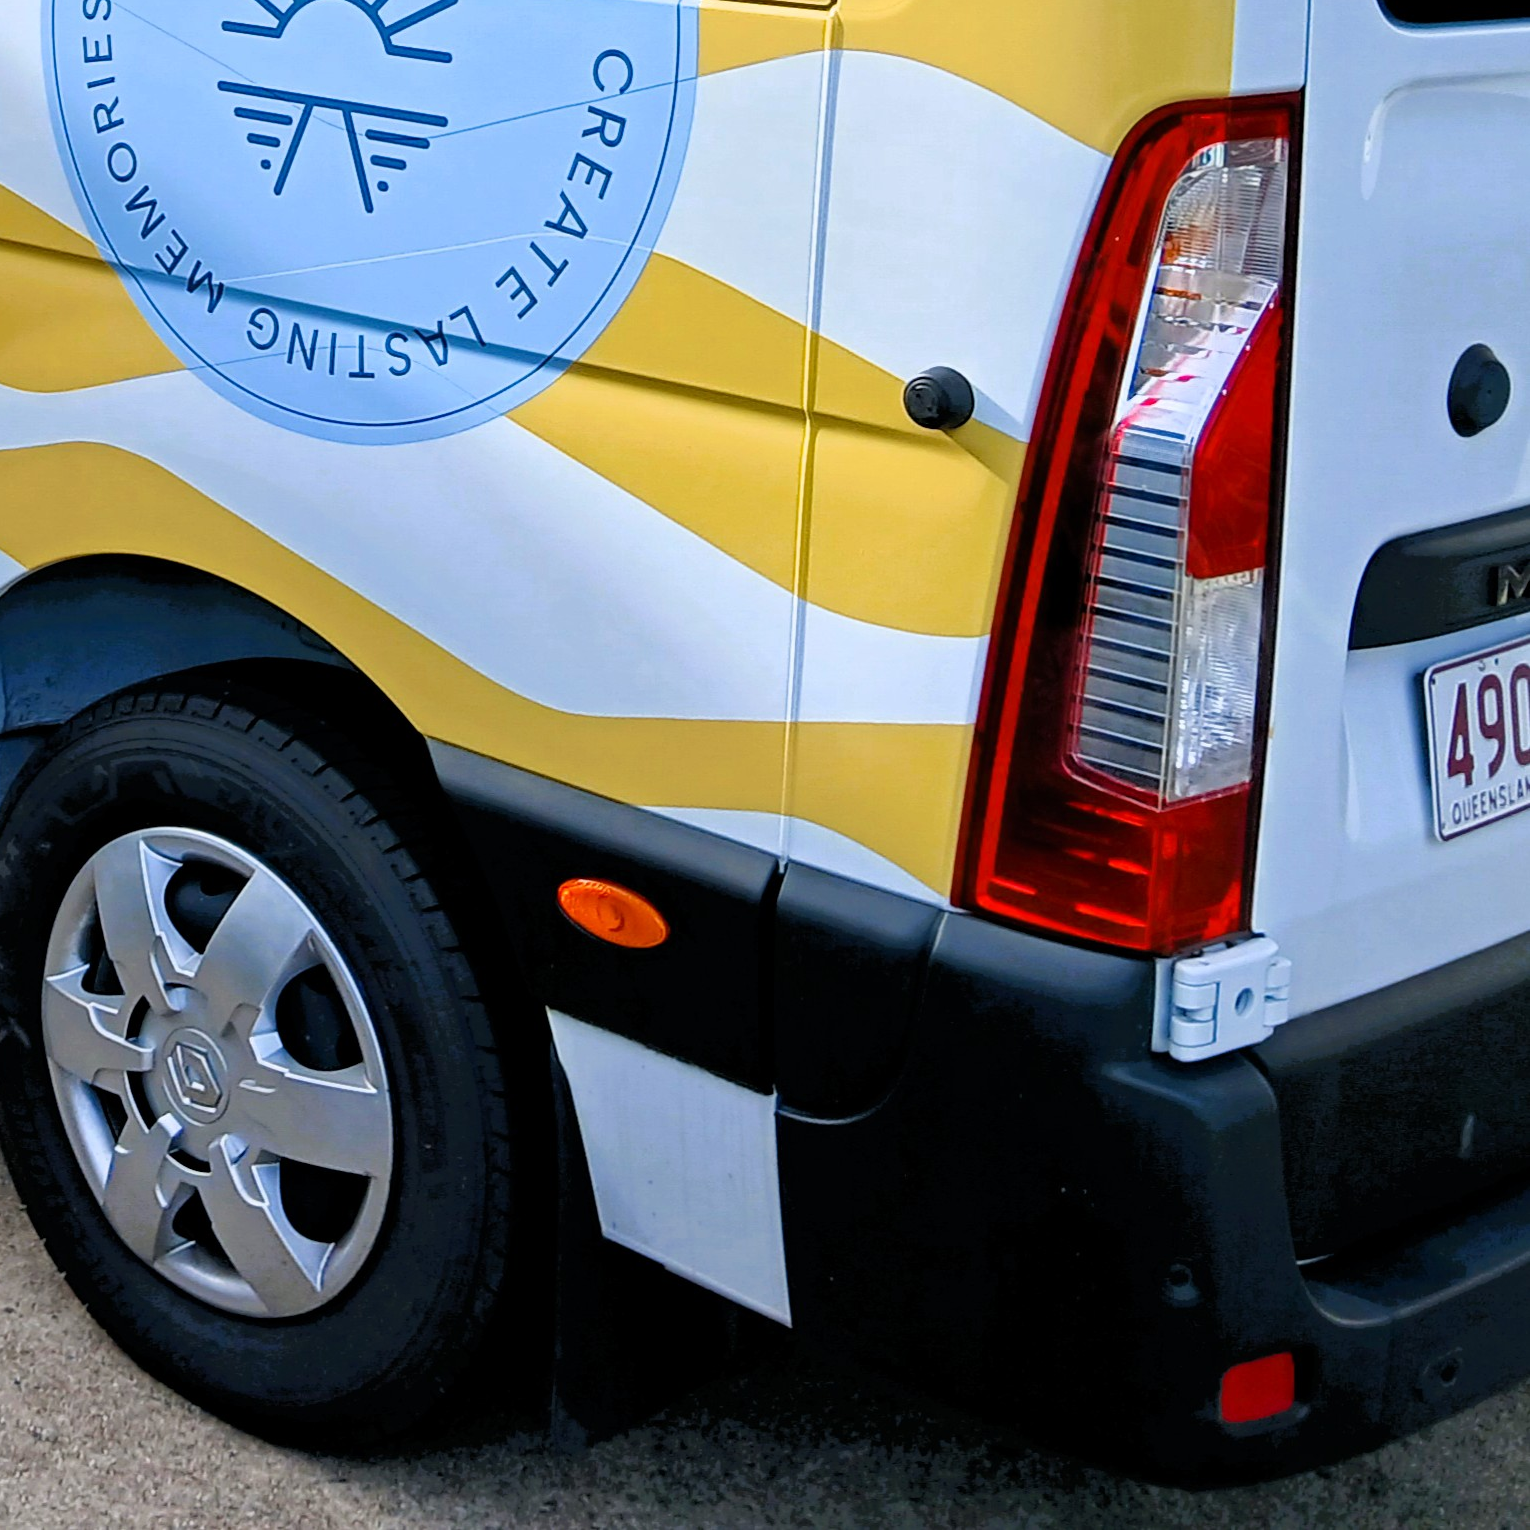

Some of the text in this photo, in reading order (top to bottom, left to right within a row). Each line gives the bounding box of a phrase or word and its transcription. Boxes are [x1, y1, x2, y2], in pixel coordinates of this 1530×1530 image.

[494, 48, 634, 320] CREATE
[245, 305, 487, 379] LASTING
[1447, 662, 1530, 788] 490
